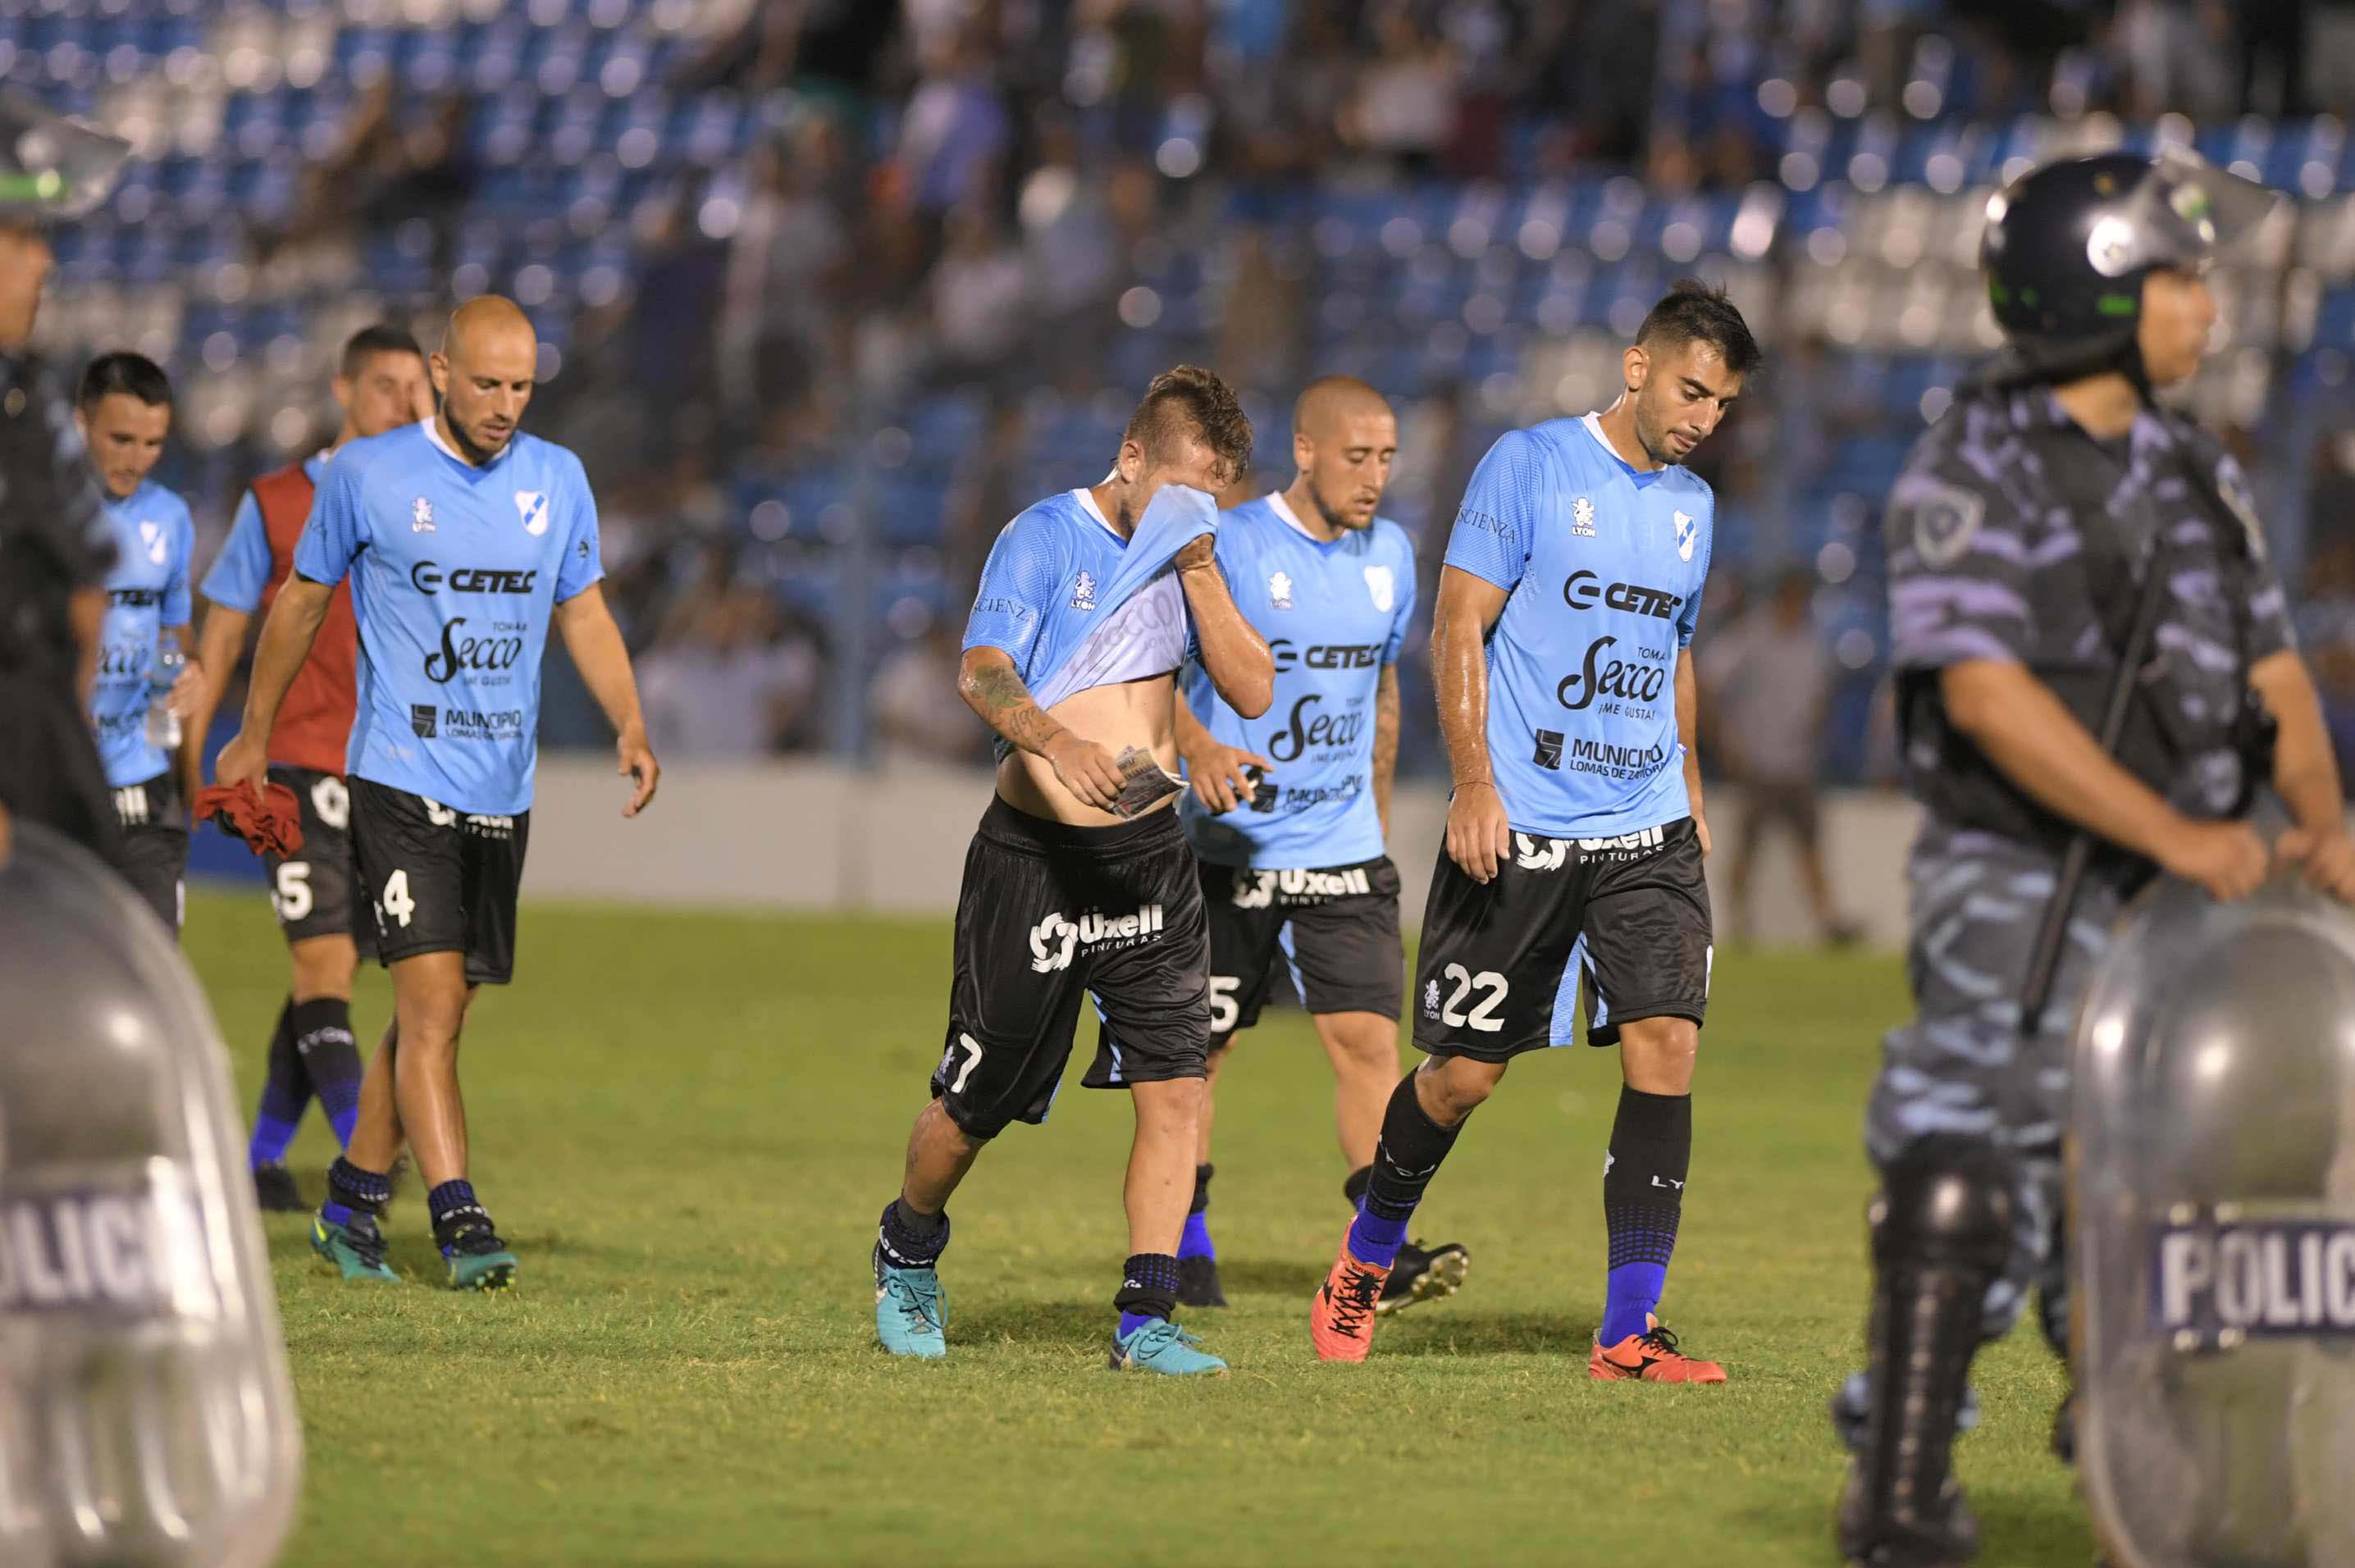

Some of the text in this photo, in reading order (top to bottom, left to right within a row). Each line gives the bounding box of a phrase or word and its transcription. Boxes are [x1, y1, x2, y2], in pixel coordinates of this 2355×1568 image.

[1572, 526, 1596, 538] LYON
[449, 568, 537, 594] CETEC
[1070, 599, 1097, 612] LYON
[424, 618, 522, 683] Secco
[1557, 636, 1665, 710] Secco
[1625, 706, 1655, 721] GUSTA!
[1570, 759, 1609, 777] LOMAS
[1611, 766, 1626, 779] DE
[382, 868, 416, 928] 4
[1442, 962, 1509, 1032] 22
[1424, 1009, 1440, 1020] LYON
[950, 1032, 984, 1095] 7
